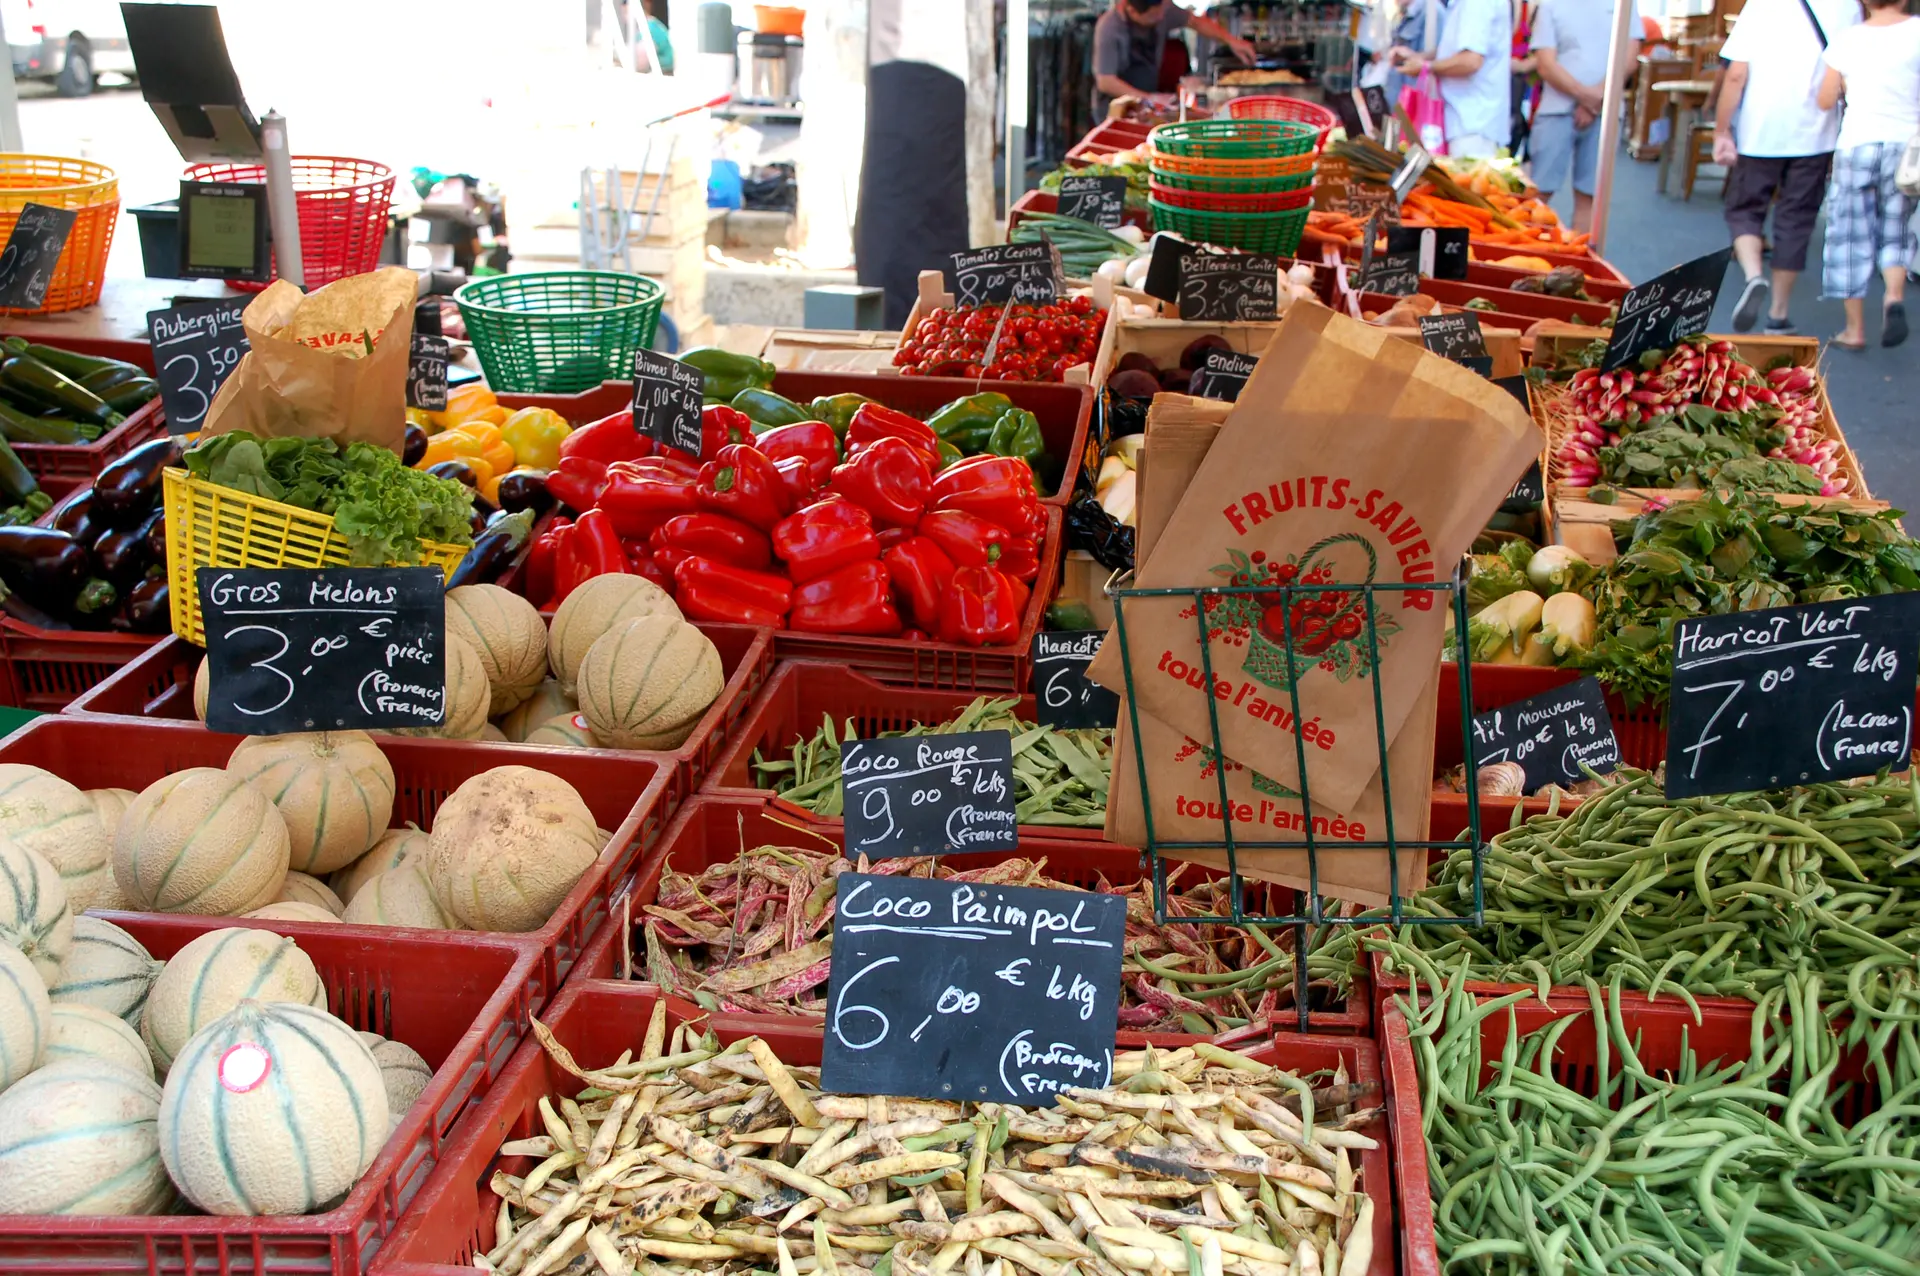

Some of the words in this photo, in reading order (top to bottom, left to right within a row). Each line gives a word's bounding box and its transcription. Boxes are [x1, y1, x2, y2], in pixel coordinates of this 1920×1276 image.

[1223, 475, 1435, 612] FRUITS-SAVEUR
[210, 573, 281, 606] Gros
[308, 579, 398, 605] Melons
[359, 617, 393, 638] €
[1807, 645, 1837, 669] €
[1157, 650, 1233, 701] toute
[1233, 682, 1336, 751] l'année
[841, 743, 900, 775] Coco
[917, 743, 979, 777] Rouge
[950, 768, 972, 786] €
[1176, 795, 1254, 823] toute
[1258, 800, 1366, 842] l'année
[840, 881, 932, 918] Coco
[994, 957, 1032, 987] €
